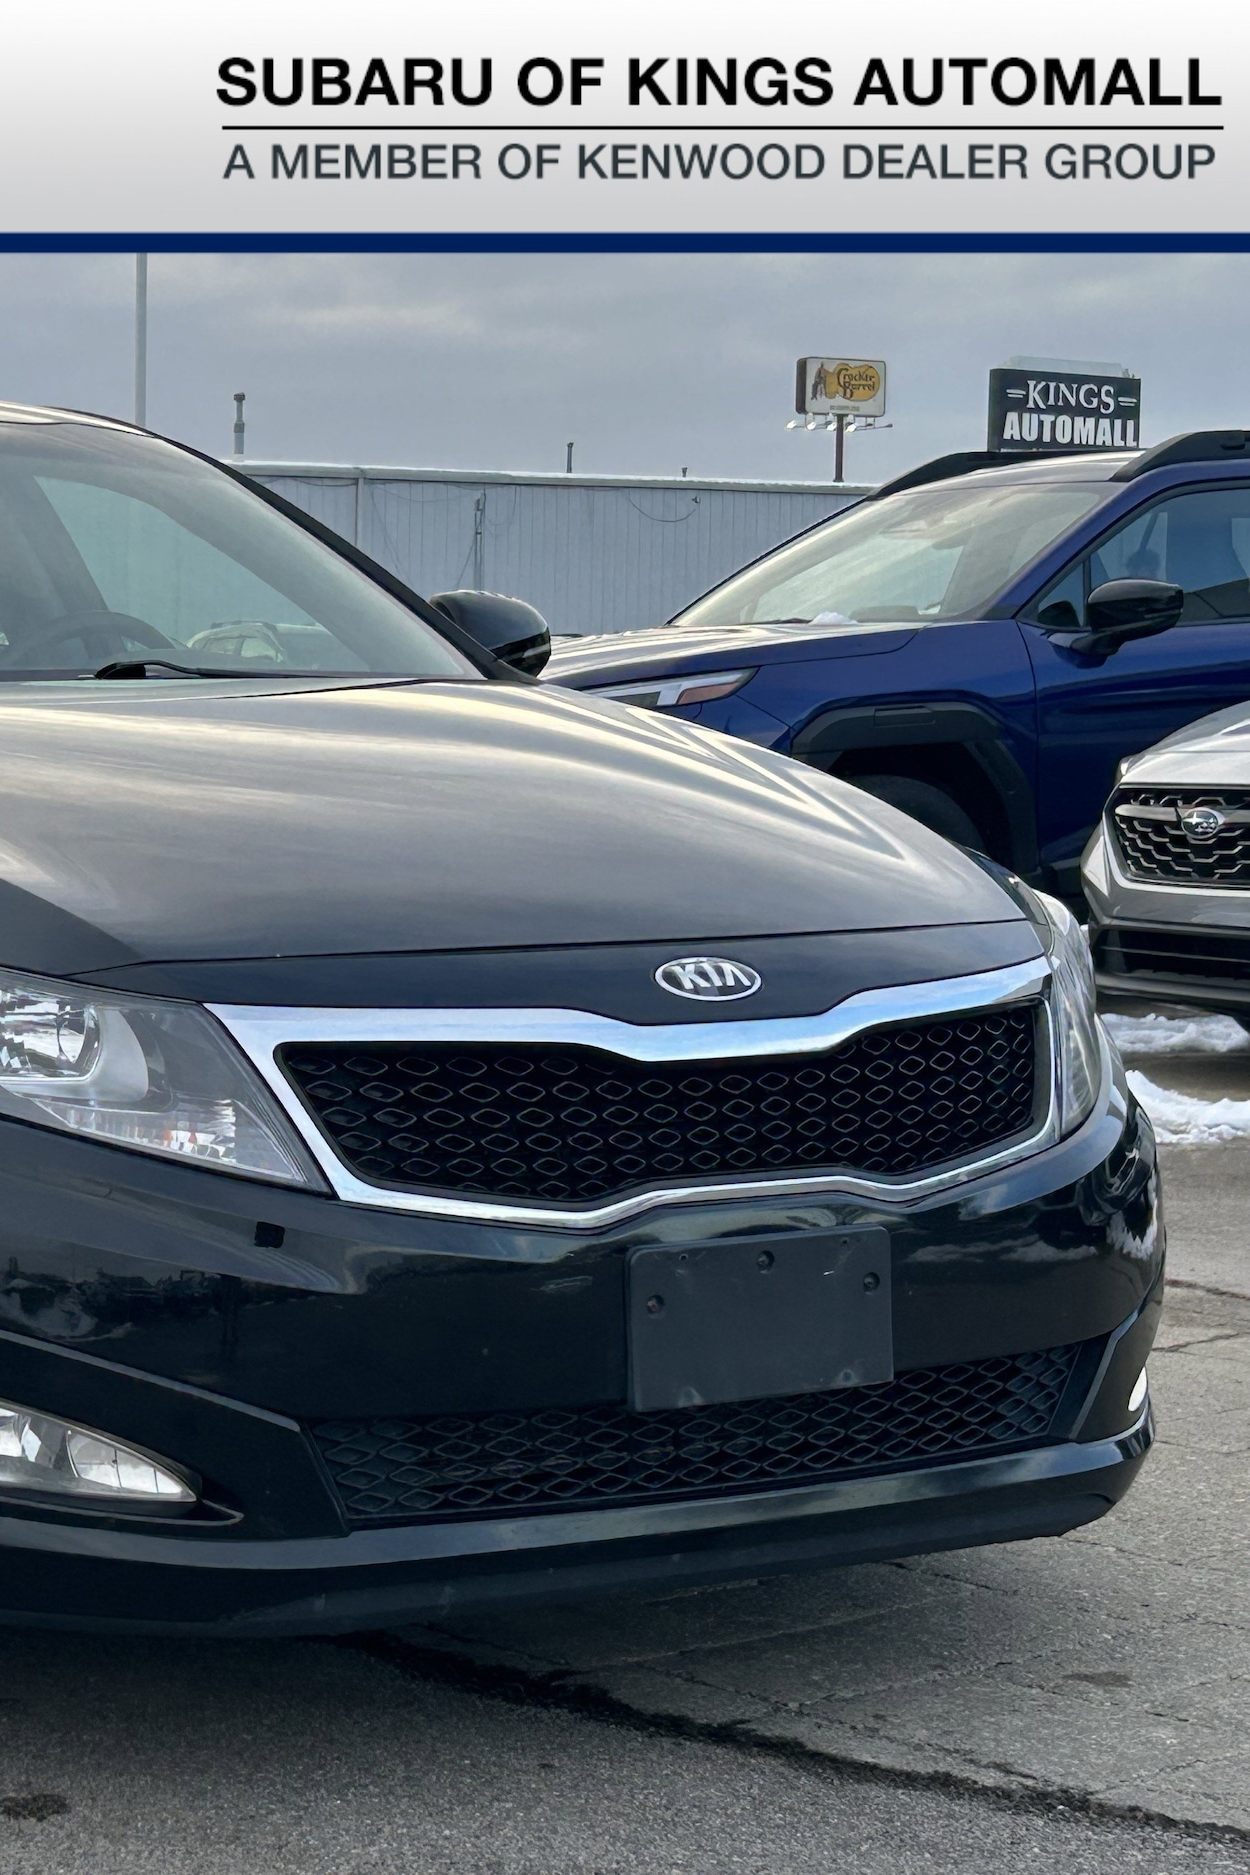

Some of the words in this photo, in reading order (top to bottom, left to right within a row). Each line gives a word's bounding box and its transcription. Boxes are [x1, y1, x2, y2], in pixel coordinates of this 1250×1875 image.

[1025, 380, 1115, 415] KINGS
[1002, 411, 1139, 448] AUTOMALL
[668, 961, 753, 991] KIA
